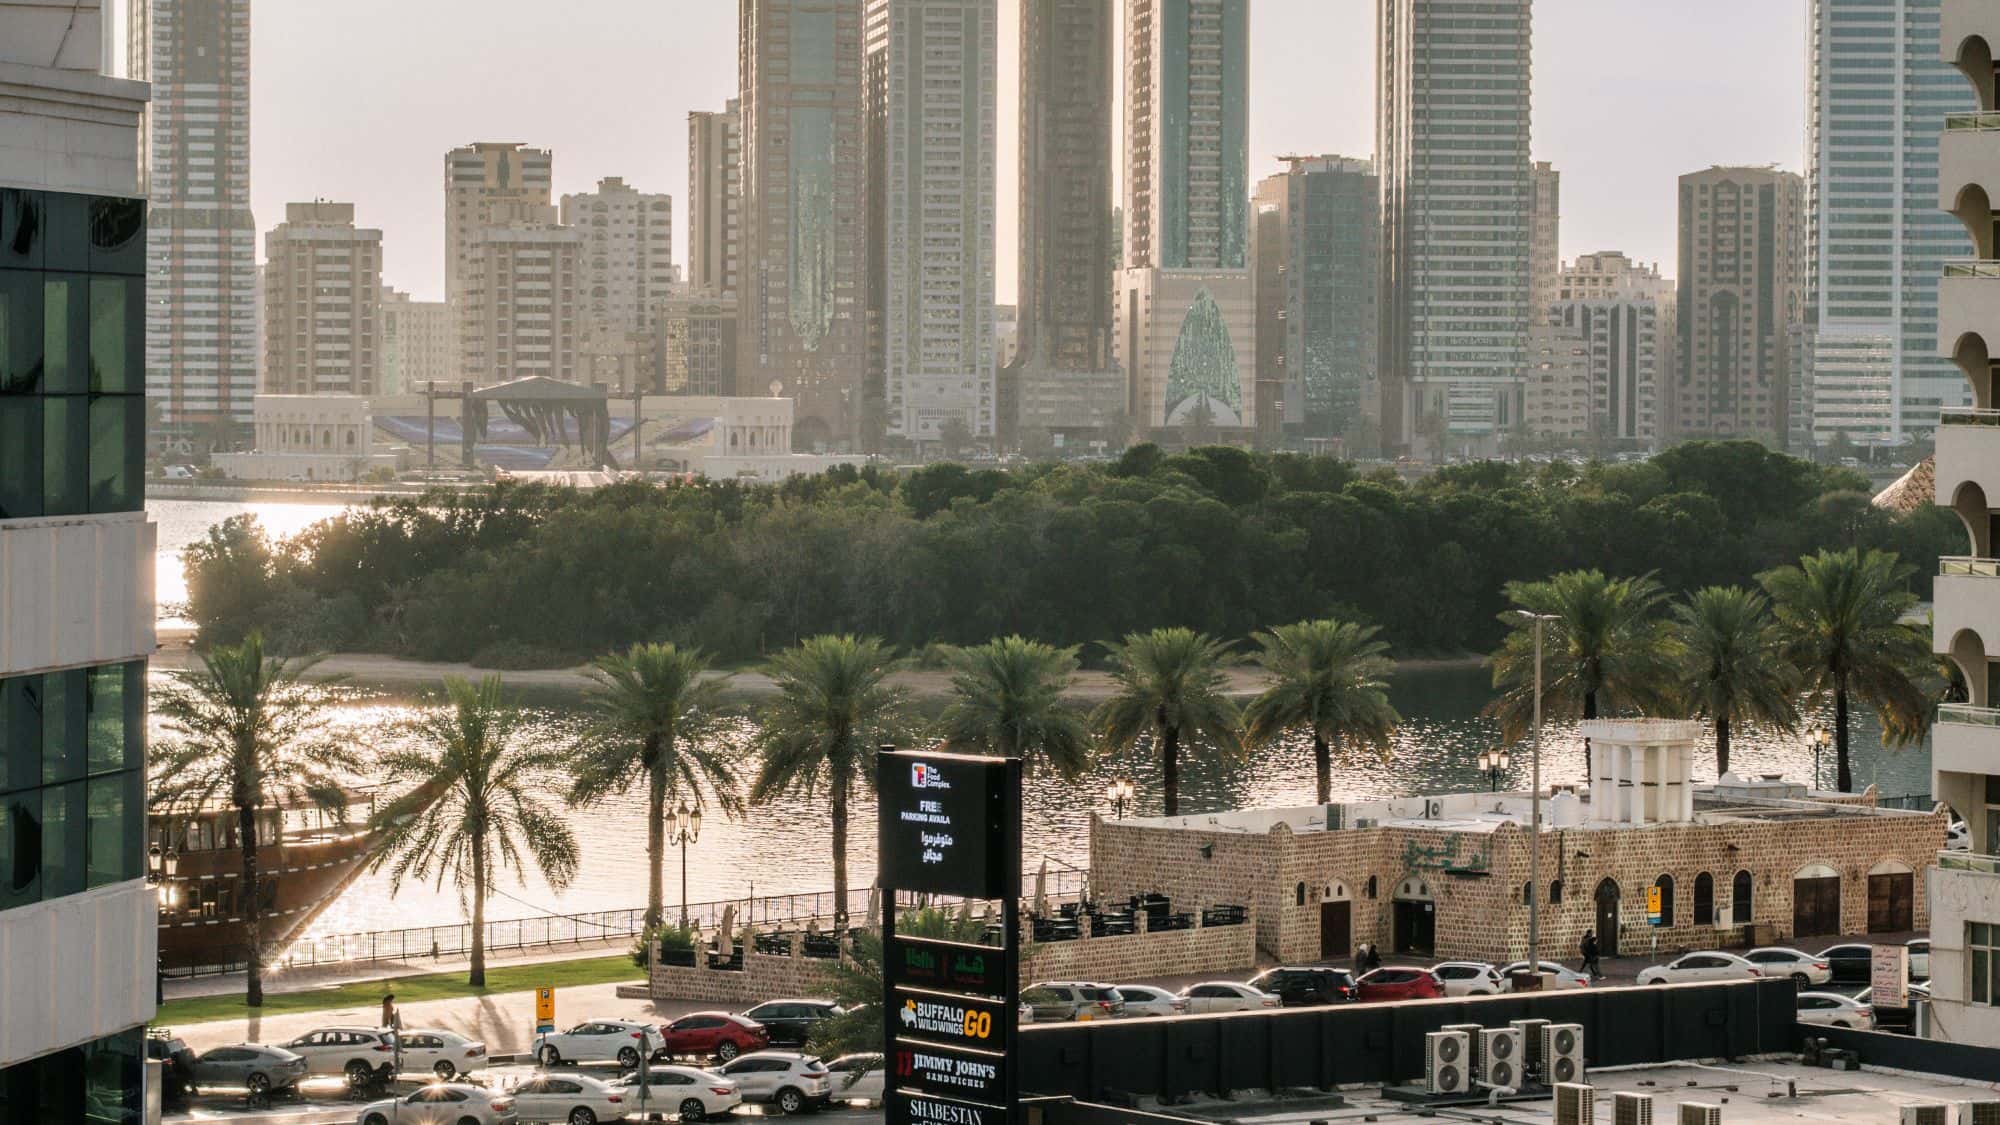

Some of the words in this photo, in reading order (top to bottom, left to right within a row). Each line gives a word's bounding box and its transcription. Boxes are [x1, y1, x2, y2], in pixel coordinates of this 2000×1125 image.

[927, 773, 941, 781] Food
[919, 800, 943, 813] FREE
[900, 811, 928, 823] PARKING
[928, 814, 951, 825] AVAILA
[916, 1002, 965, 1023] BUFFALO
[964, 1009, 992, 1039] GO
[913, 1053, 953, 1071] JIMMY
[955, 1059, 996, 1079] JOHN'S
[925, 1072, 985, 1089] SANDWICHES
[910, 1099, 983, 1125] SHABESTAN
